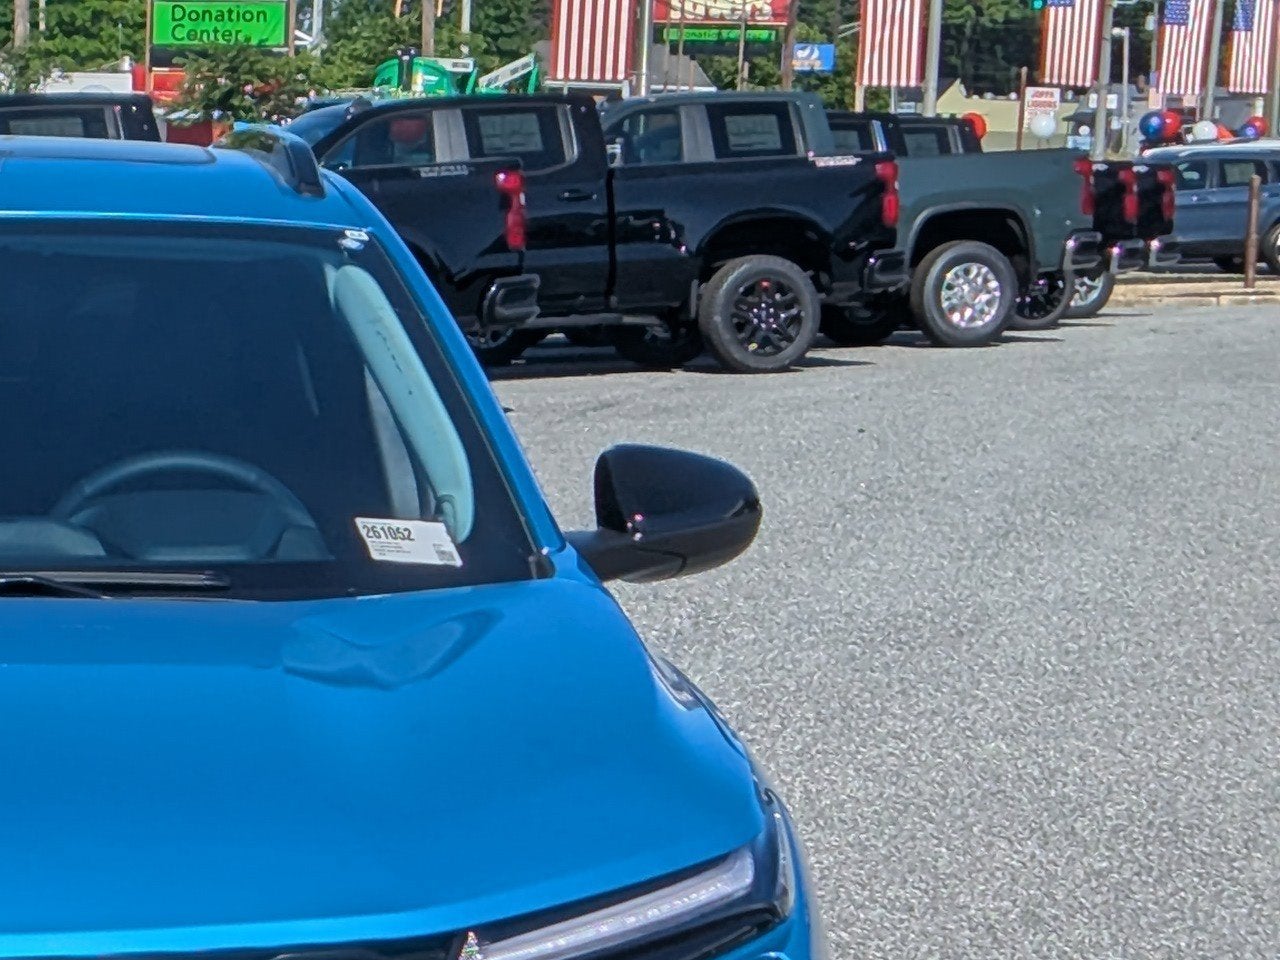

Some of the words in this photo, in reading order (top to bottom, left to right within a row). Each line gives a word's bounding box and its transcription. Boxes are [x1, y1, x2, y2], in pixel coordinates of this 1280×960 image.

[171, 4, 268, 22] Donation
[171, 23, 243, 42] Center
[362, 524, 415, 541] 261052
